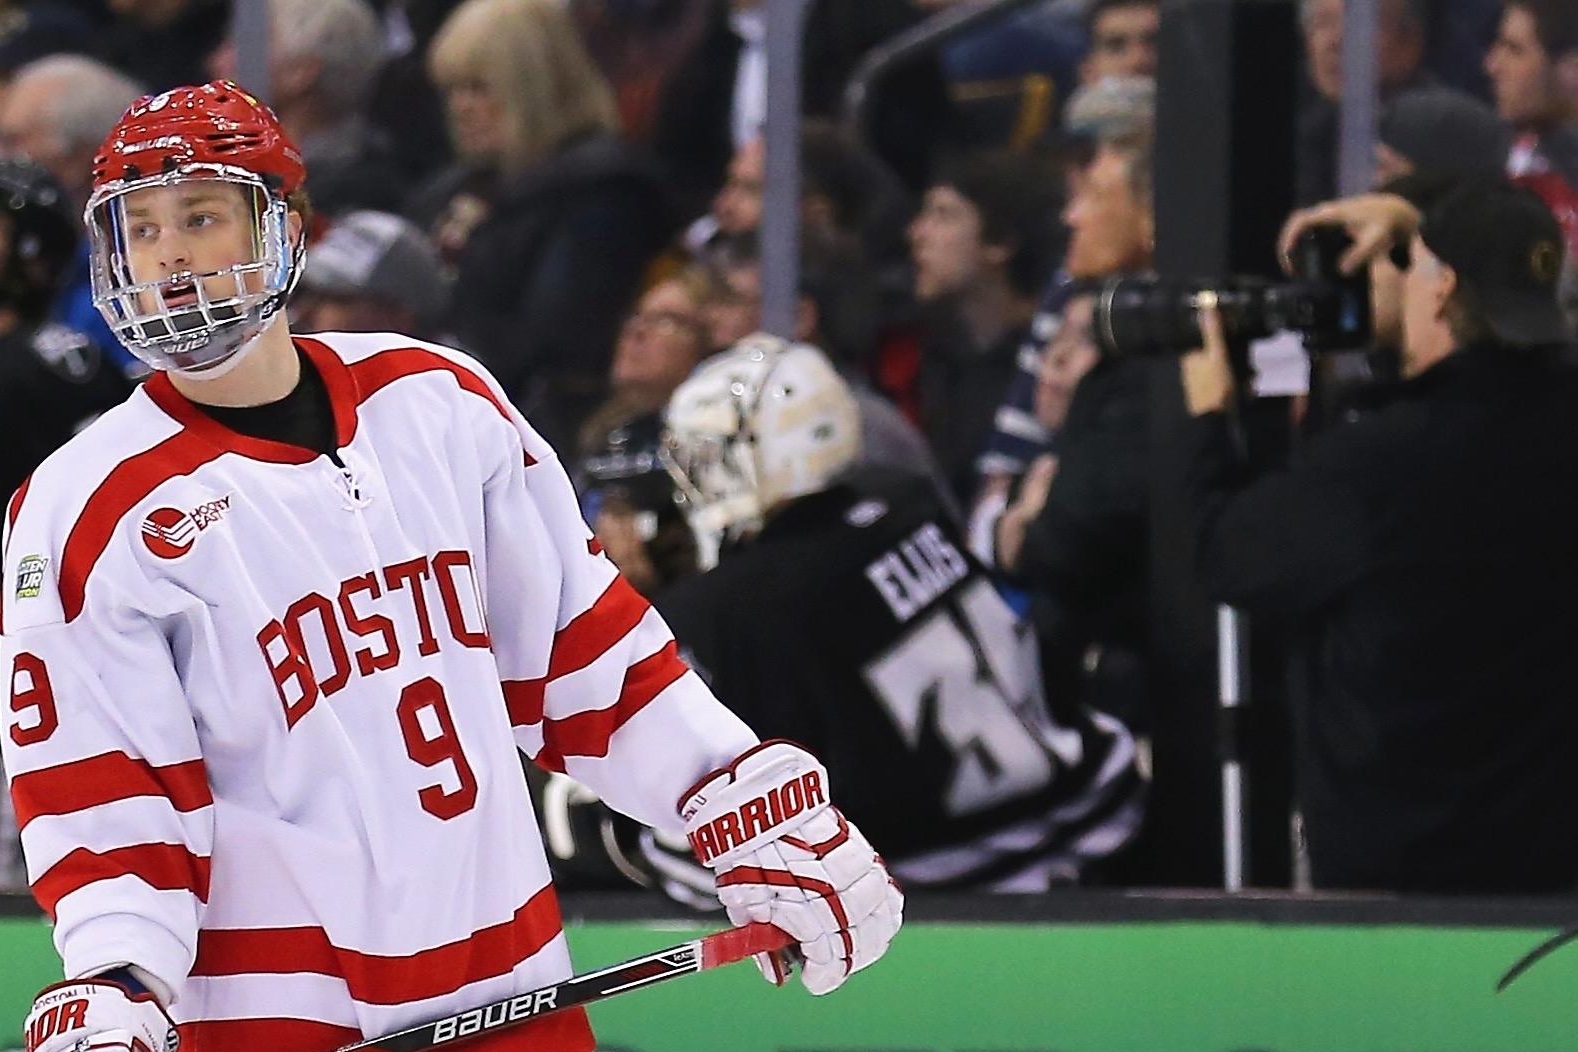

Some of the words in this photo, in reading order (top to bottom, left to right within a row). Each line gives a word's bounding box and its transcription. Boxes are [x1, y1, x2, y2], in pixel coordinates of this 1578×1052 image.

[9, 651, 59, 747] 9
[256, 550, 492, 733] BOSTO
[397, 676, 479, 821] 9
[433, 986, 559, 1044] BAUER
